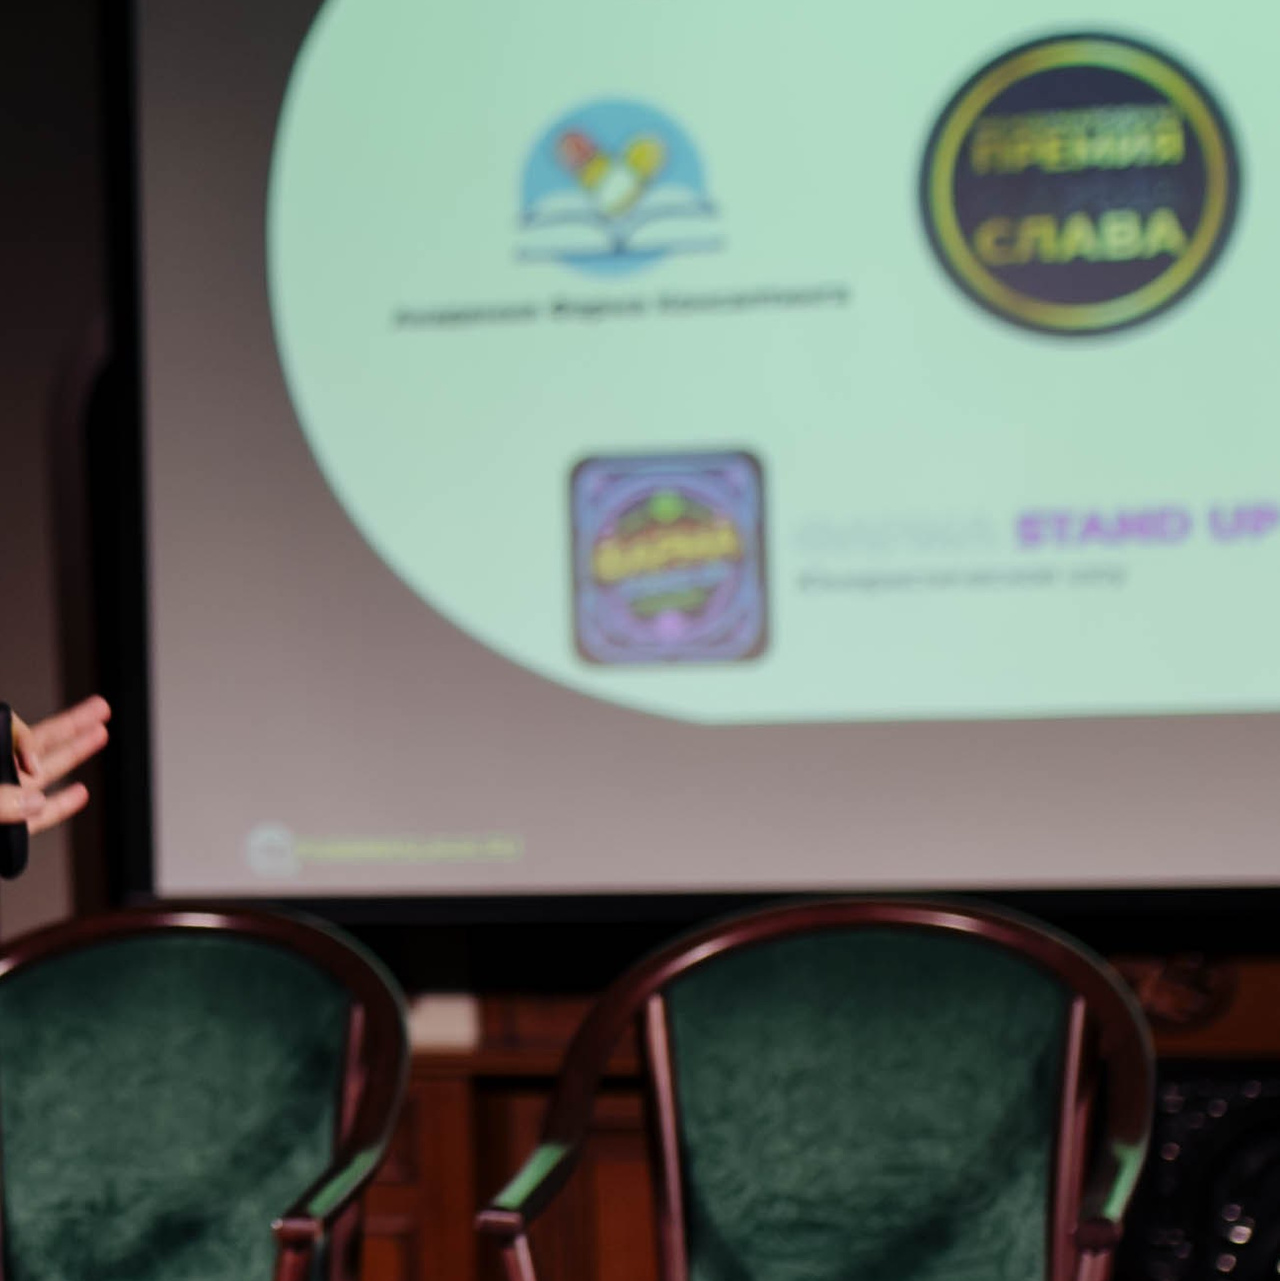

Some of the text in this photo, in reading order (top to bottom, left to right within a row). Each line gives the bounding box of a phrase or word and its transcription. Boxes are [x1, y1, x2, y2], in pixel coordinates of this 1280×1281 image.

[972, 207, 1189, 266] СЛАВА
[1015, 506, 1194, 551] STAND
[1207, 499, 1280, 544] UP
